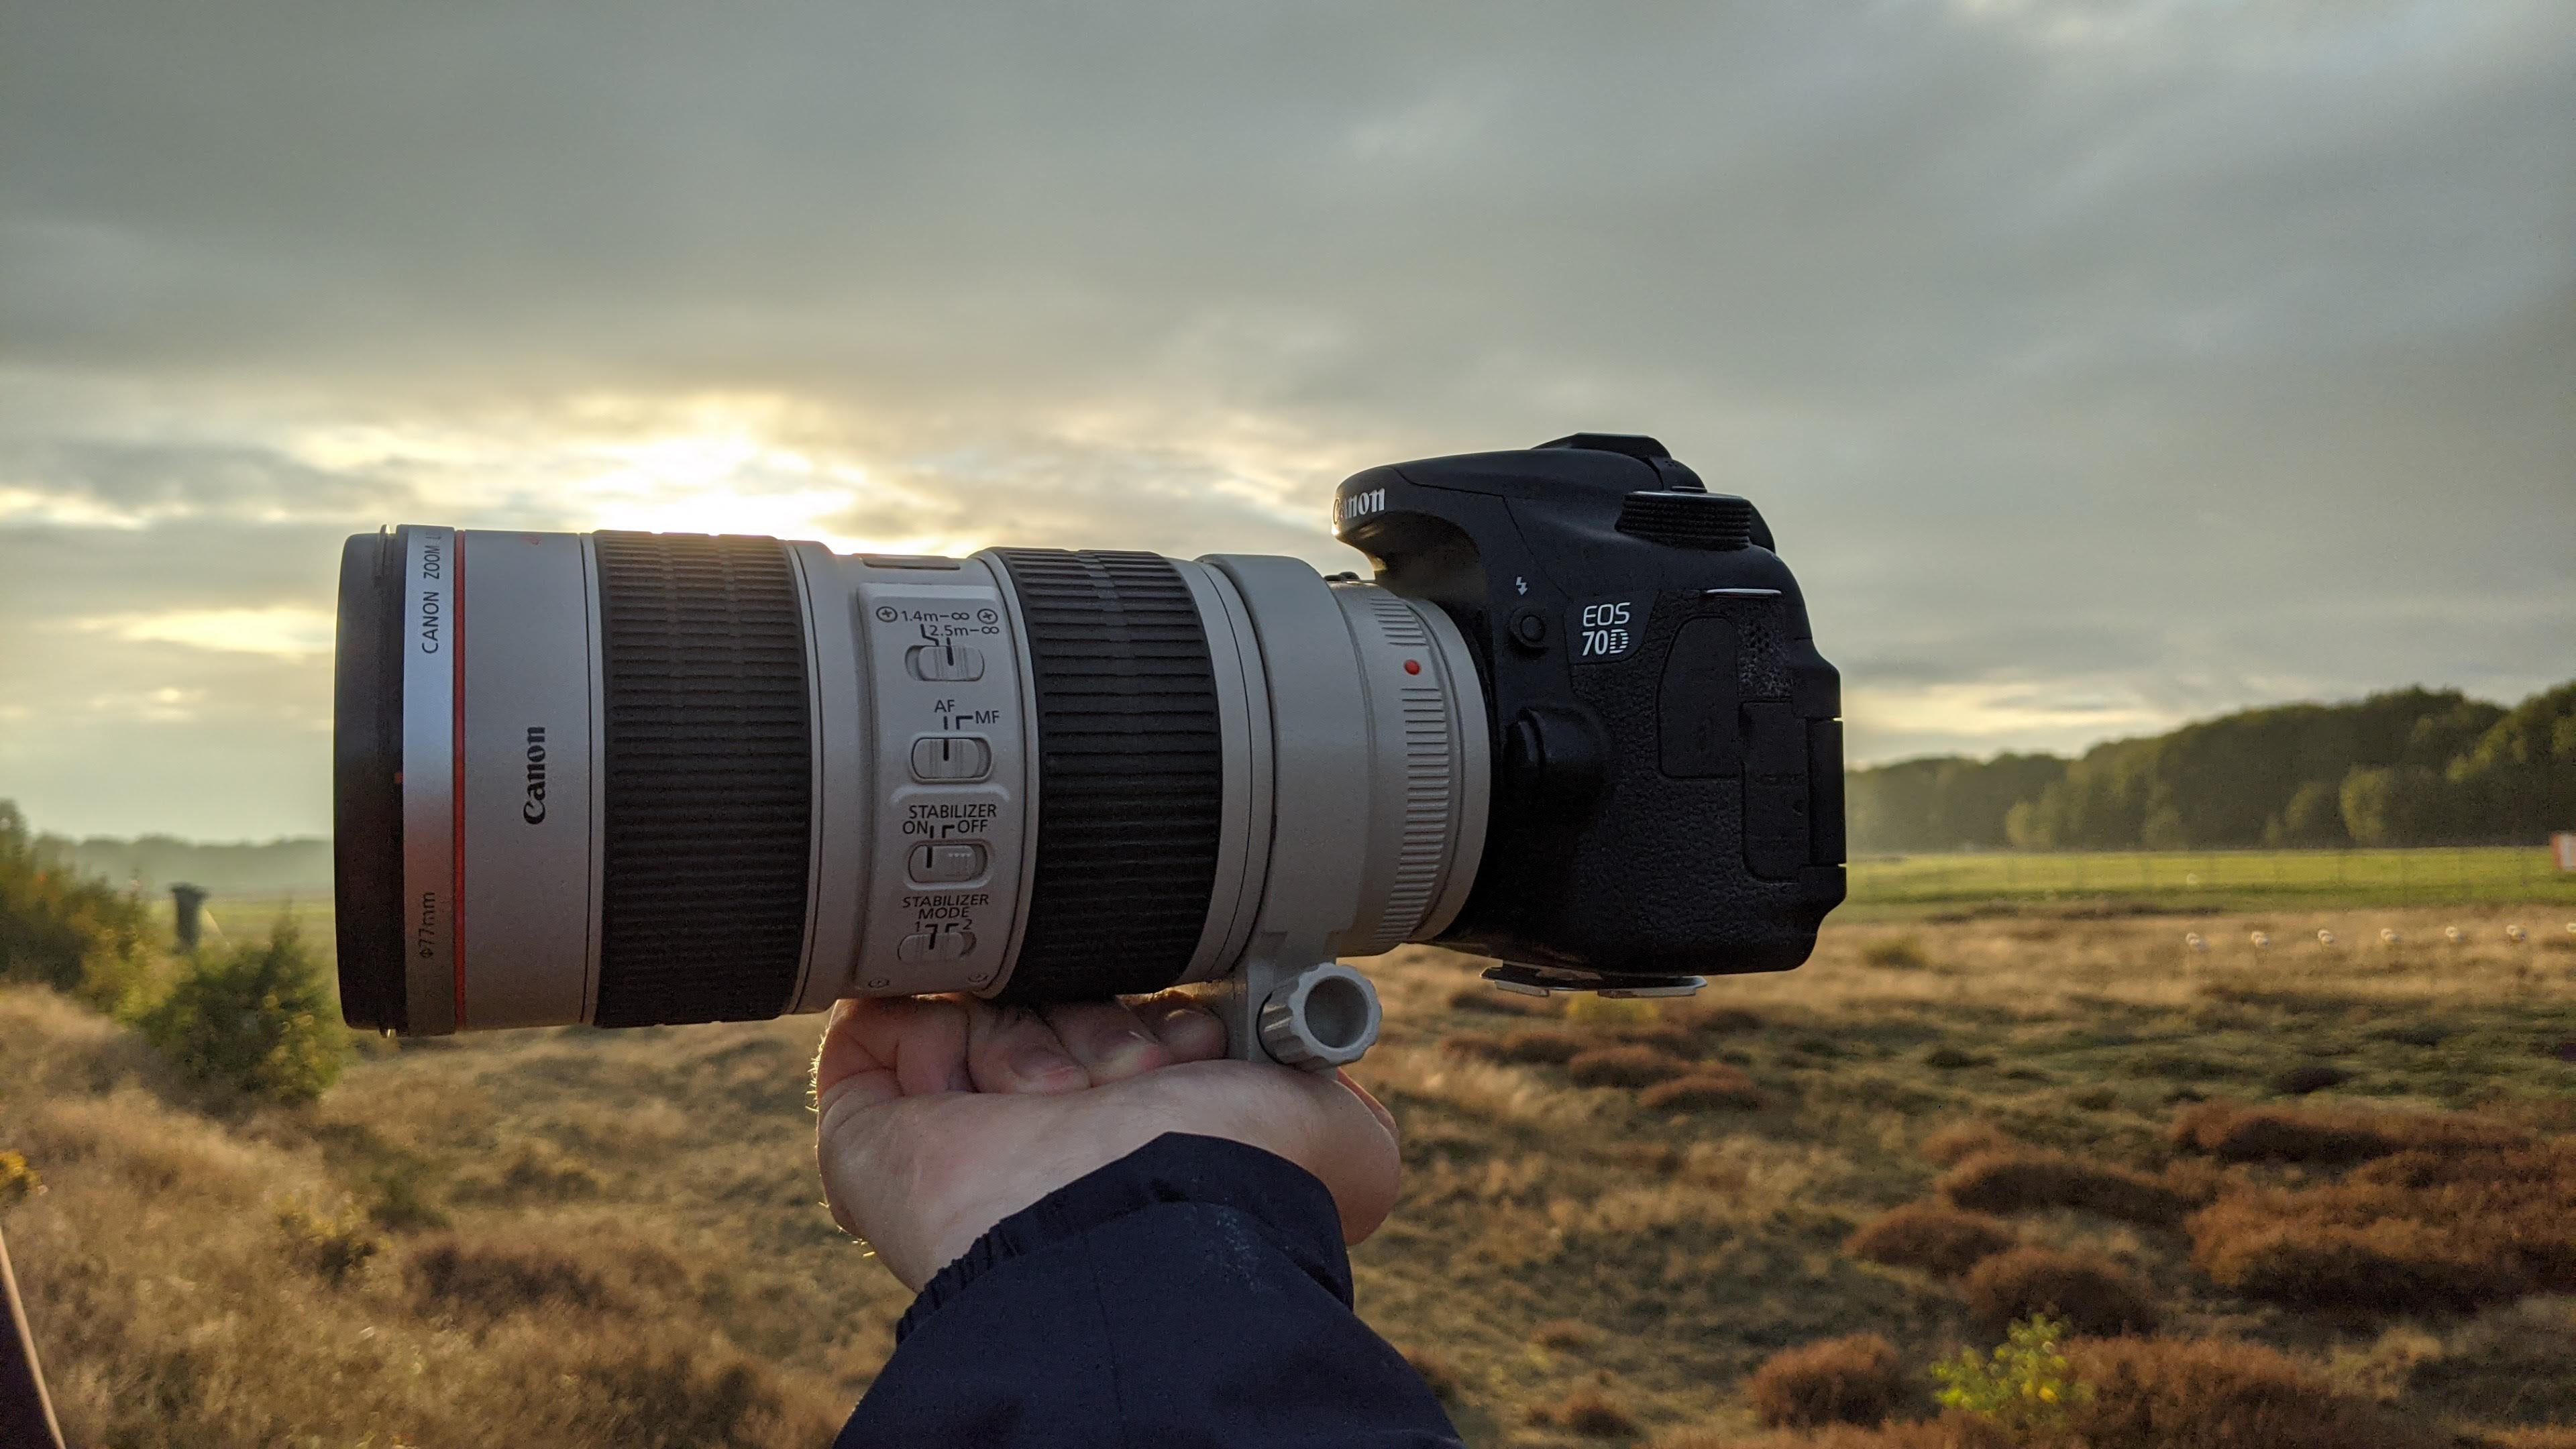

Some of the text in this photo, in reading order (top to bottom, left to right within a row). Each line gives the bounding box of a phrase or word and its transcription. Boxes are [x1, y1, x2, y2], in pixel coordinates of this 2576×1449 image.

[423, 545, 440, 580] ZOOM
[1583, 602, 1631, 627] EOS
[422, 592, 439, 654] CANON
[1582, 629, 1629, 656] 70D
[934, 700, 955, 713] AF
[975, 710, 1000, 724] MF
[523, 727, 545, 824] Canon
[909, 804, 997, 818] STABILIZER
[902, 820, 928, 834] ON
[957, 819, 988, 833] OFF
[902, 894, 989, 908] STABILIZER
[918, 907, 970, 919] MODE
[963, 919, 972, 930] 2
